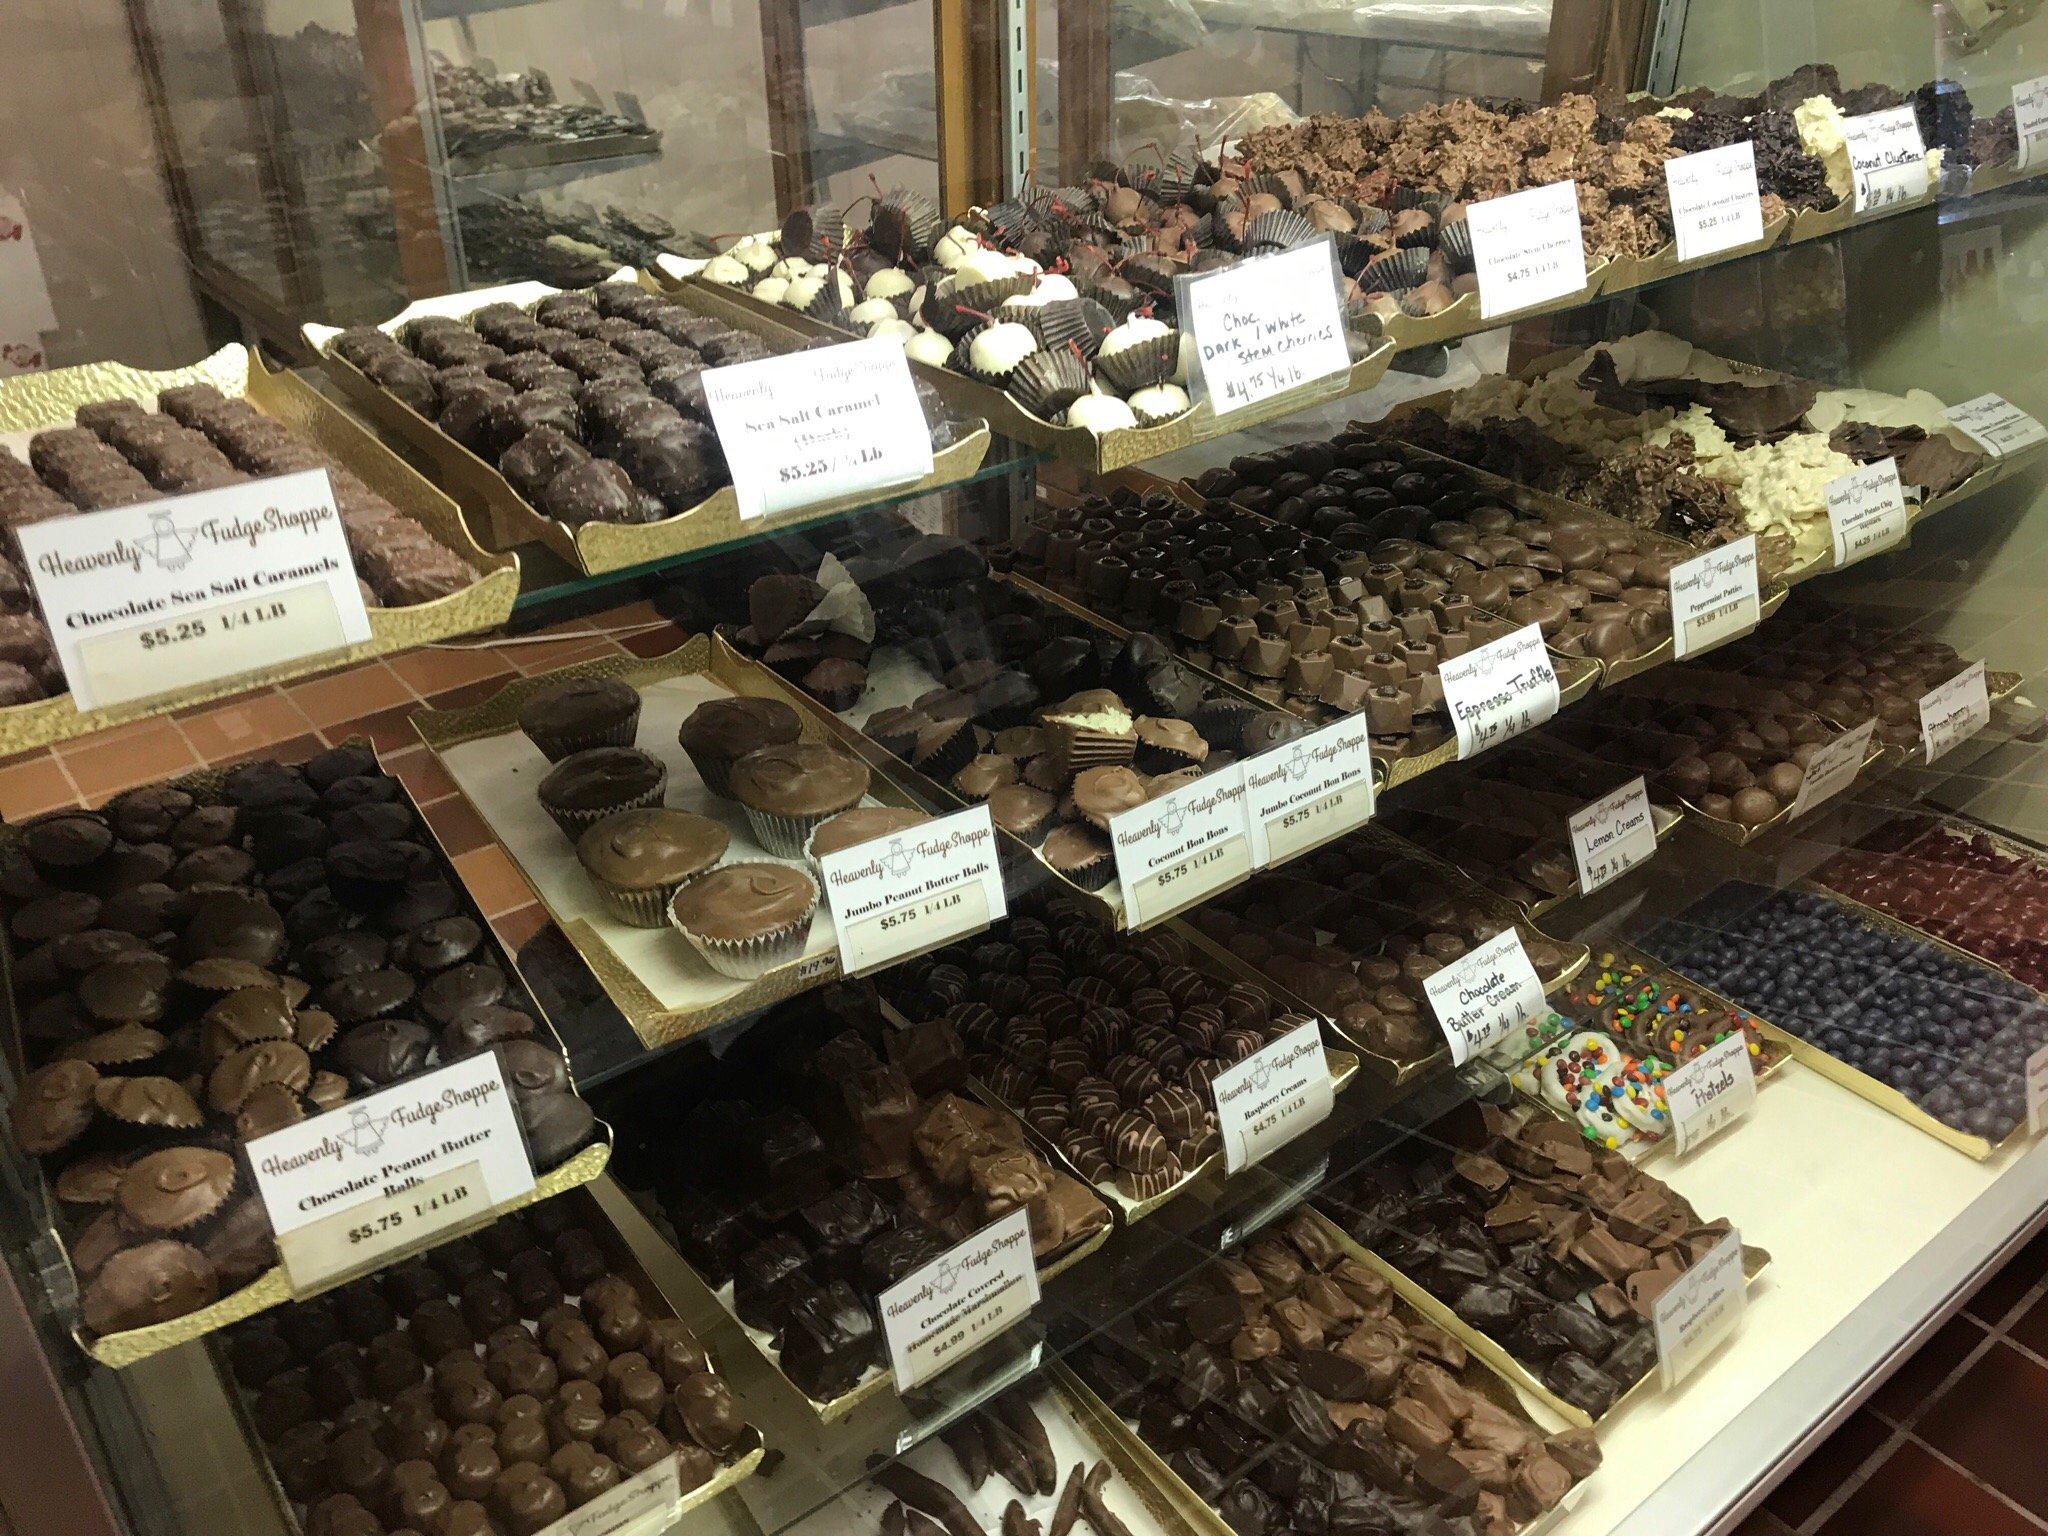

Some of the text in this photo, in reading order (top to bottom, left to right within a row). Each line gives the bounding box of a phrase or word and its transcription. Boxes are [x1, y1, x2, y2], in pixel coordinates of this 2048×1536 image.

[1853, 153, 1881, 171] Coconut
[1698, 216, 1718, 230] $5.25
[1507, 267, 1530, 283] $4.75
[1203, 338, 1242, 361] Dark
[1265, 313, 1306, 335] White
[1223, 312, 1260, 332] Choc
[745, 393, 882, 434] Sea Salt Caramel
[38, 539, 141, 579] Heavenly
[66, 556, 340, 630] Chocolate Sea Salt Caramels
[1690, 584, 1743, 613] Peppermint Patties
[139, 618, 207, 651] $5.25
[255, 601, 288, 621] LB
[1444, 663, 1478, 683] Heavenly
[1455, 664, 1555, 721] Espresso Truffle
[1248, 762, 1287, 790] Heavenly
[1260, 767, 1362, 818] Jumbo Coconut Bon Bons
[1282, 808, 1310, 829] $5.75
[1329, 794, 1344, 809] LB
[1117, 819, 1161, 848] Heavenly
[1148, 824, 1229, 869] Coconut Bon Bons
[1584, 811, 1645, 853] Lemon Creams
[830, 858, 884, 888] Heavenly
[1157, 863, 1188, 887] $5.75
[1209, 847, 1225, 864] LB
[844, 862, 990, 920] Jumbo Peanut Butter Balls
[880, 910, 917, 931] $5.75
[944, 894, 962, 909] LB
[1429, 972, 1461, 997] Heavenly
[1459, 971, 1506, 1006] Chocolate
[1447, 981, 1522, 1032] Butter Cream
[1219, 1075, 1253, 1105] Heavenly
[1244, 1077, 1308, 1121] Raspberry Creams
[1690, 1070, 1735, 1108] Pretzels
[1253, 1114, 1277, 1136] $4.75
[261, 1134, 343, 1179] Heavenly
[297, 1128, 493, 1213] Chocolate Peanut Butter
[382, 1175, 425, 1199] Balls
[348, 1211, 404, 1244] $5.75
[441, 1185, 468, 1207] LB
[887, 1284, 934, 1319] Heavenly
[920, 1268, 1006, 1330] Chocolate Covered
